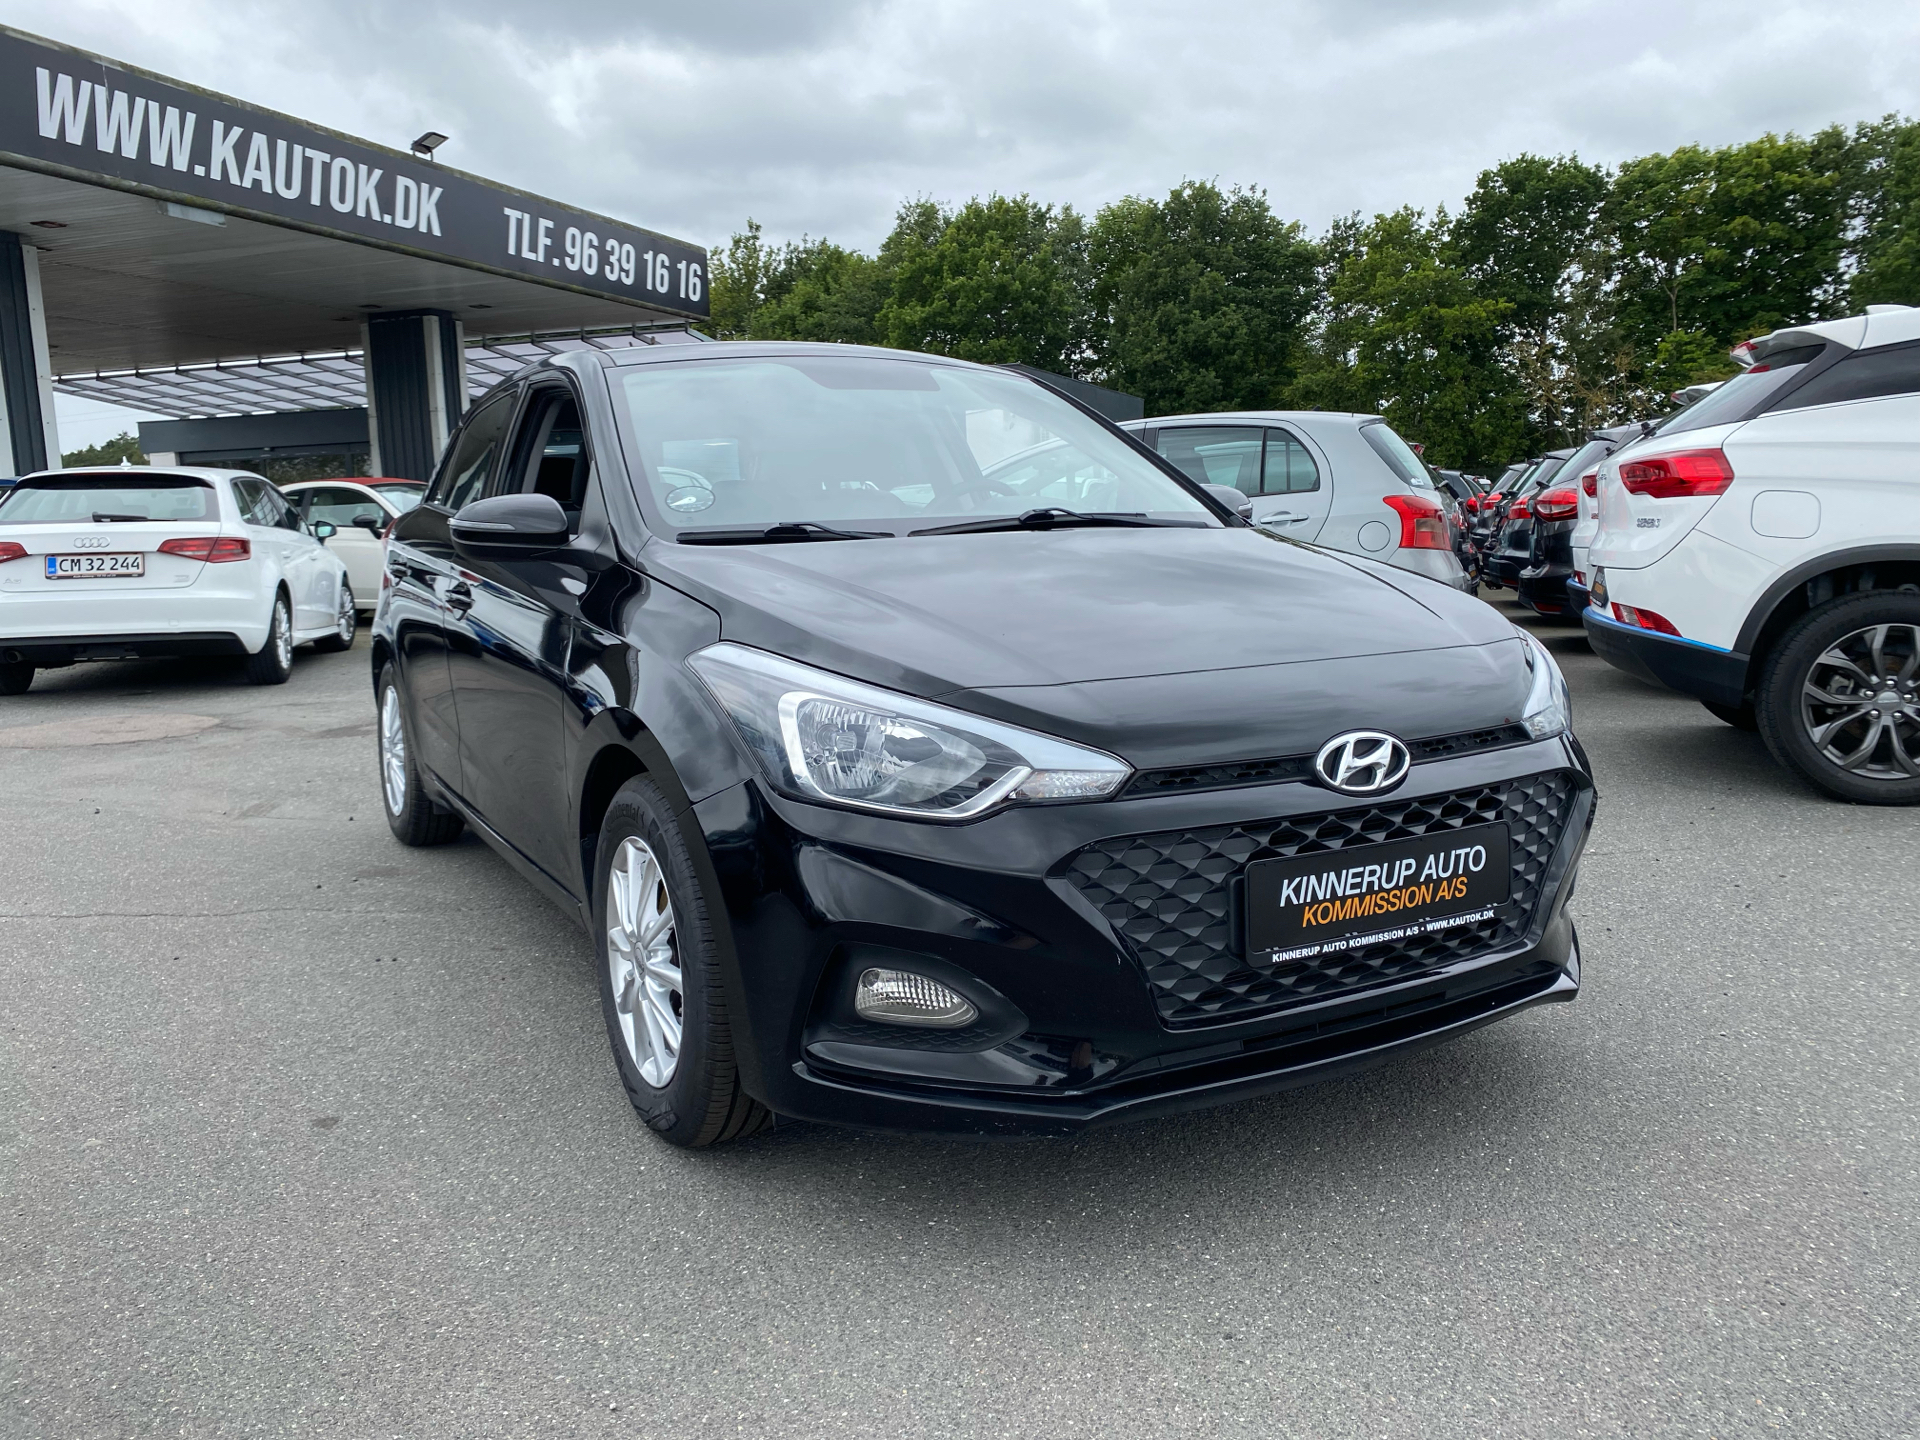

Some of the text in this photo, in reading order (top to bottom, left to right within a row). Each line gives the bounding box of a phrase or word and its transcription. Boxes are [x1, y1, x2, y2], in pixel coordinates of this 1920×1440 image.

[35, 66, 444, 237] WWW.KAUTOK.DK
[604, 238, 636, 286] 39
[643, 249, 670, 294] 16
[676, 260, 702, 302] 16
[59, 556, 140, 572] CM 32 244
[1279, 845, 1487, 908] KINNERUP AUTO
[1302, 876, 1468, 927] KOMMISSION A/S
[1271, 909, 1495, 963] KINNERUP AUTO KOMMISSION A/S WWW.KAUTOK.DK
